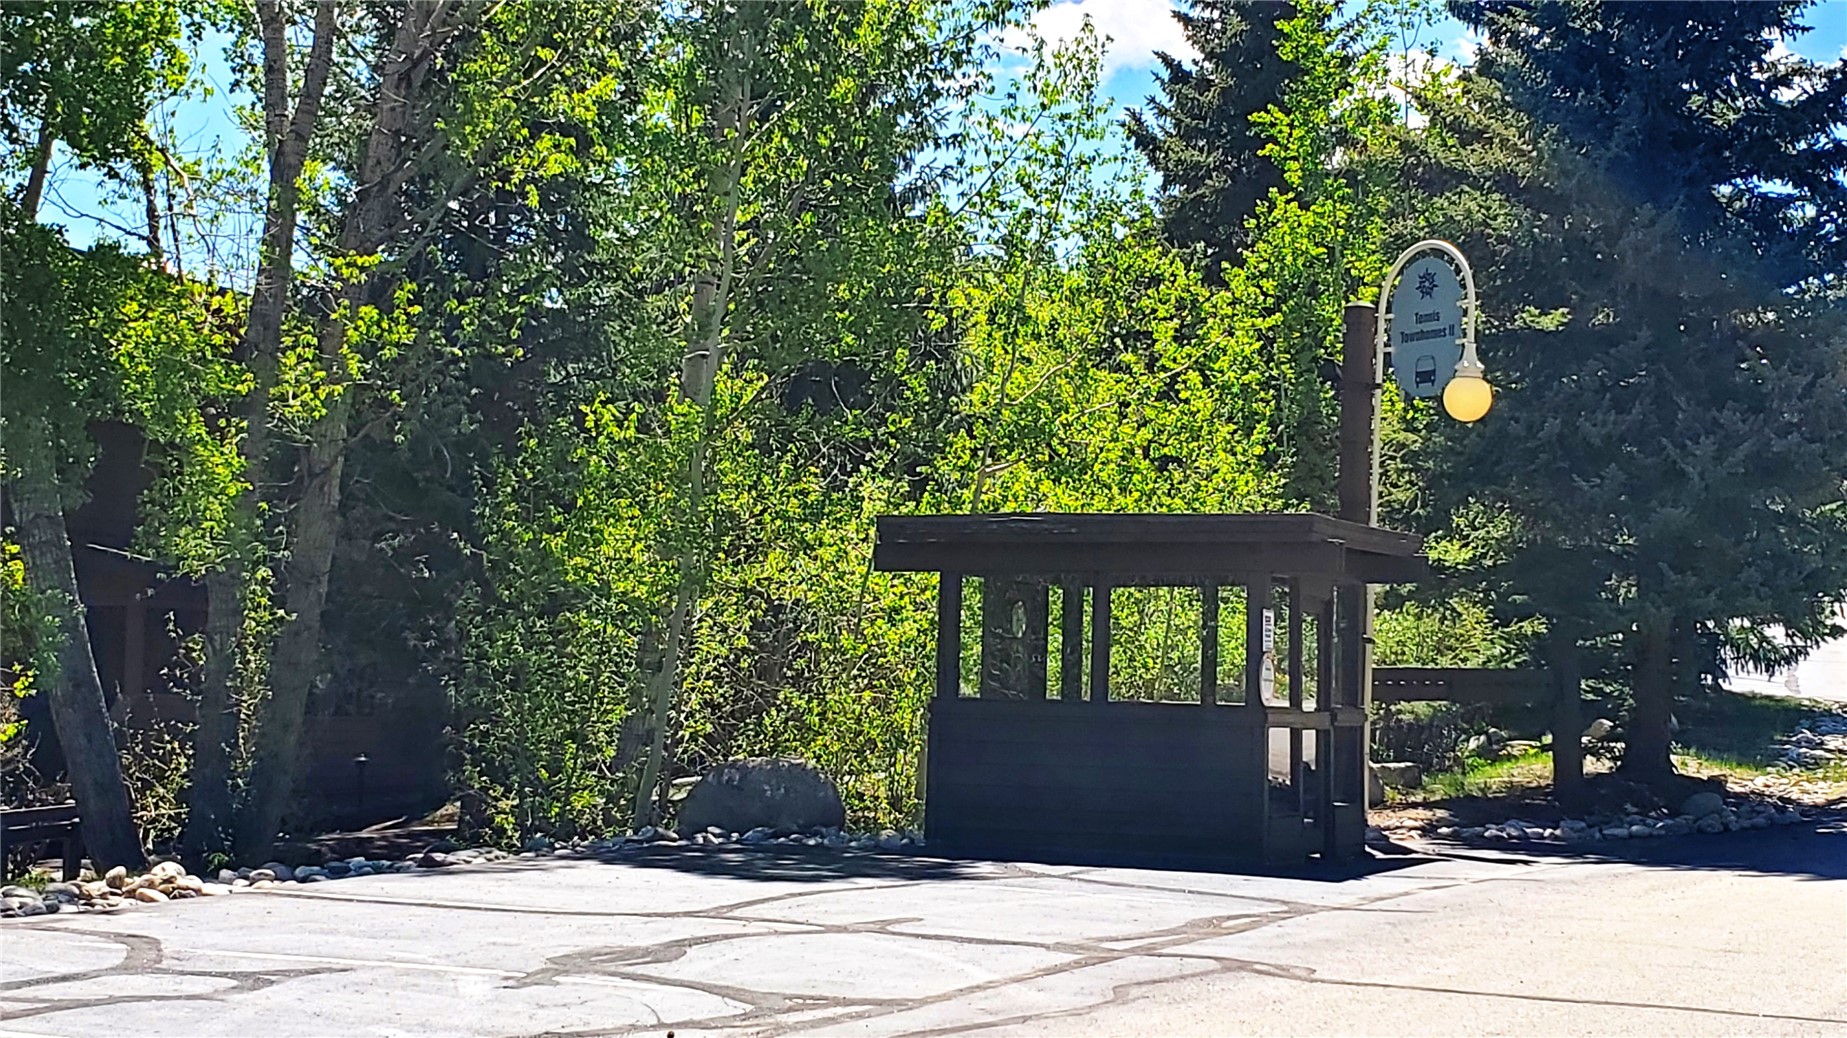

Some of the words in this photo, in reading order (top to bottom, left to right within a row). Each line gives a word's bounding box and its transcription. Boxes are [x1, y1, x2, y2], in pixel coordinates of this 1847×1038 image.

[1414, 310, 1440, 325] Tennis
[1400, 327, 1447, 344] Townhomes
[1448, 324, 1455, 337] II
